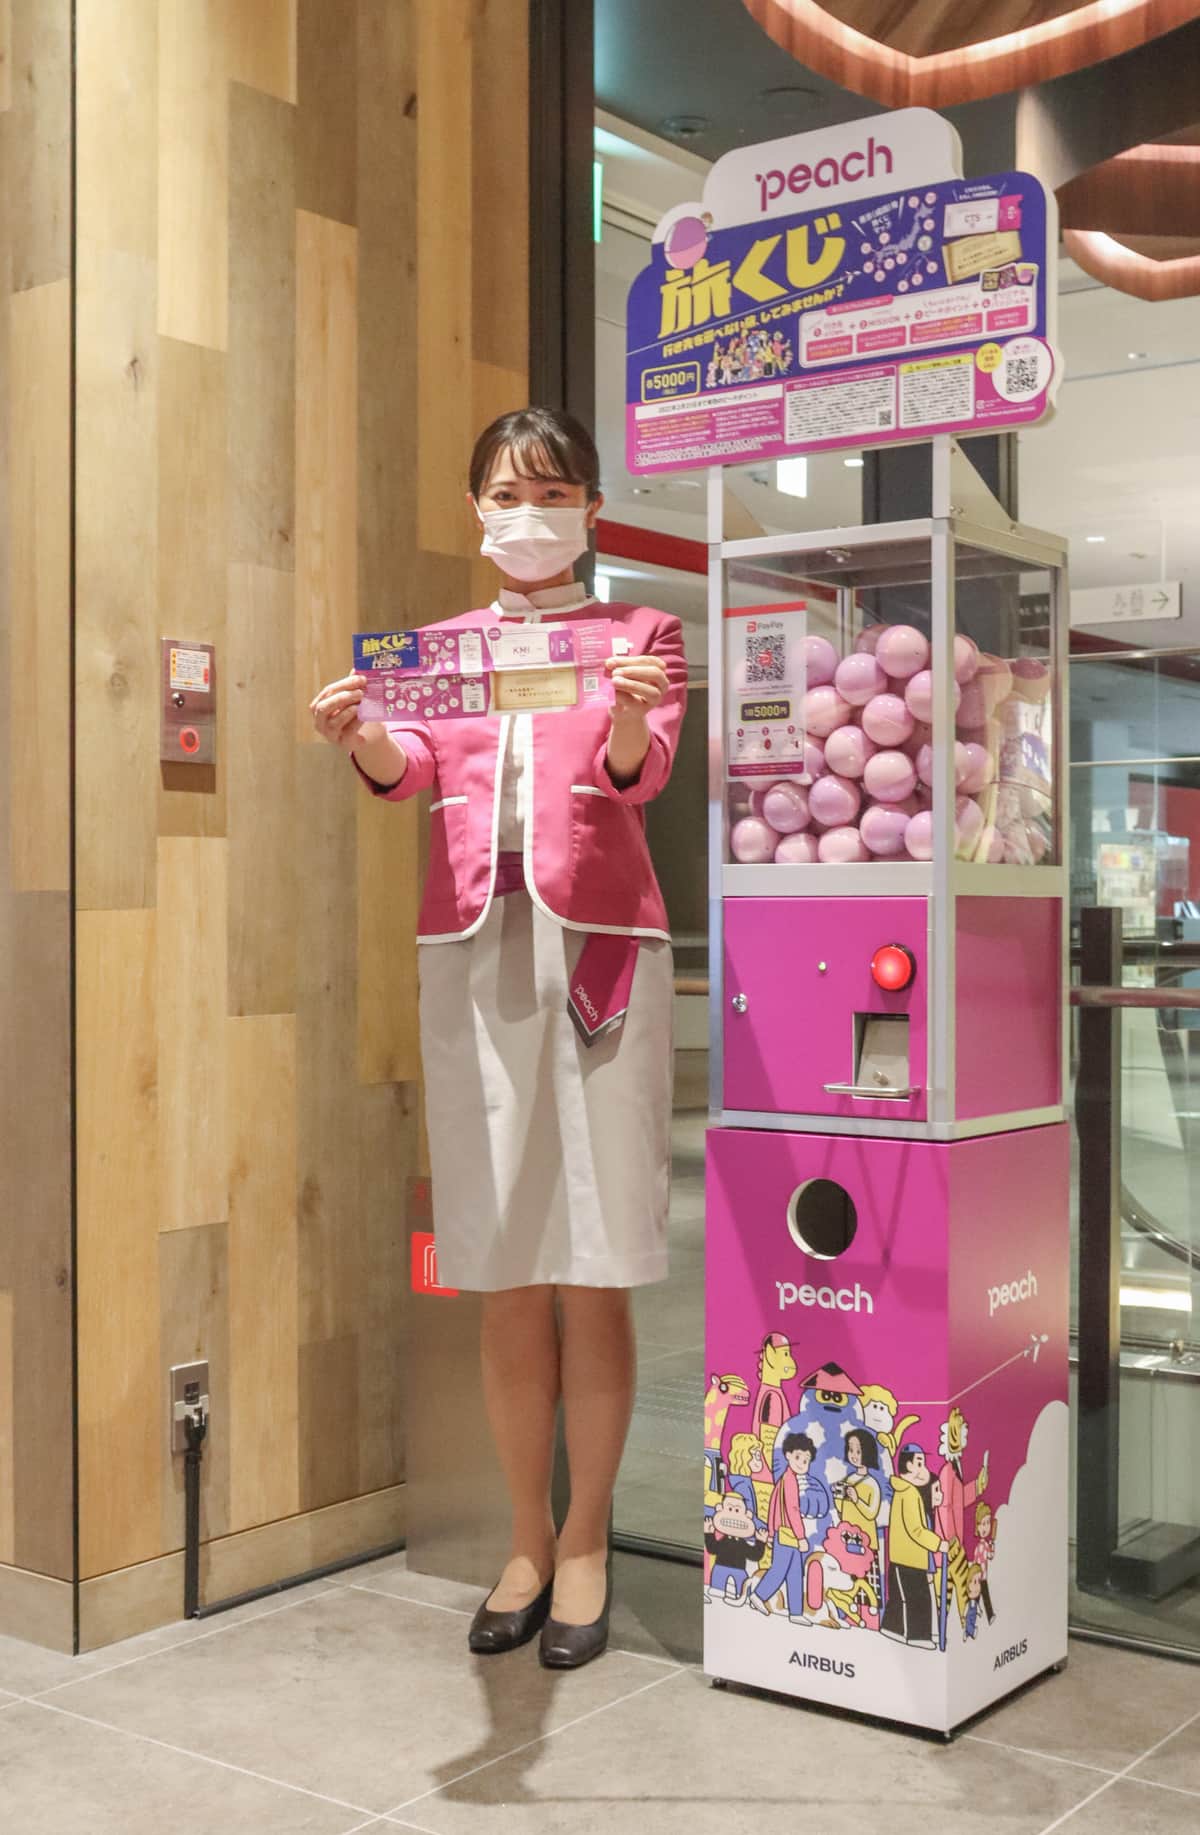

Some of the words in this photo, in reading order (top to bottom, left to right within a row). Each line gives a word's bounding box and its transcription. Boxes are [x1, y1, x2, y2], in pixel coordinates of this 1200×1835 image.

[755, 137, 893, 212] peach
[658, 213, 846, 340] 旅くじ
[574, 984, 599, 1022] peach
[775, 1281, 874, 1314] peach
[987, 1270, 1038, 1317] peach
[788, 1650, 856, 1678] AIRBUS
[993, 1639, 1028, 1672] AIRBUS
